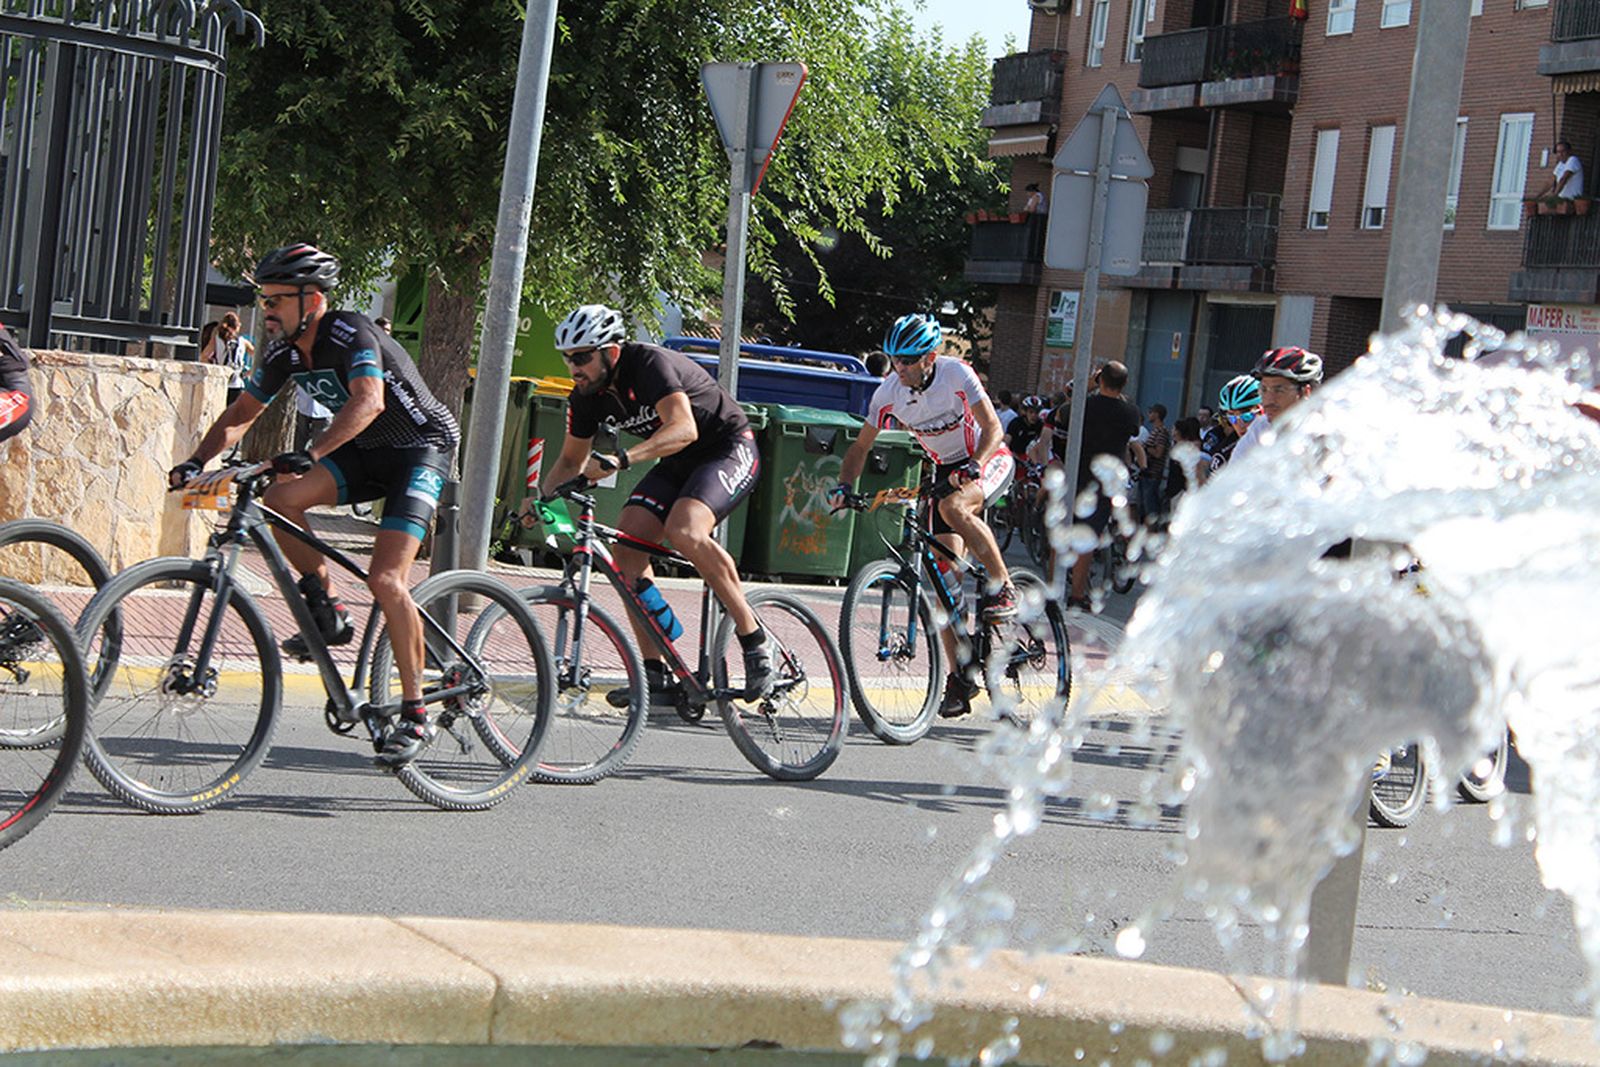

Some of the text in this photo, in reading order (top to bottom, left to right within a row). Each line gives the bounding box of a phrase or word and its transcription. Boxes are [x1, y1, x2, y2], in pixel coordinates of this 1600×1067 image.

[1528, 306, 1563, 328] MAFER
[304, 378, 338, 399] AC
[718, 443, 754, 495] Castelli
[191, 773, 240, 803] MAXXIS
